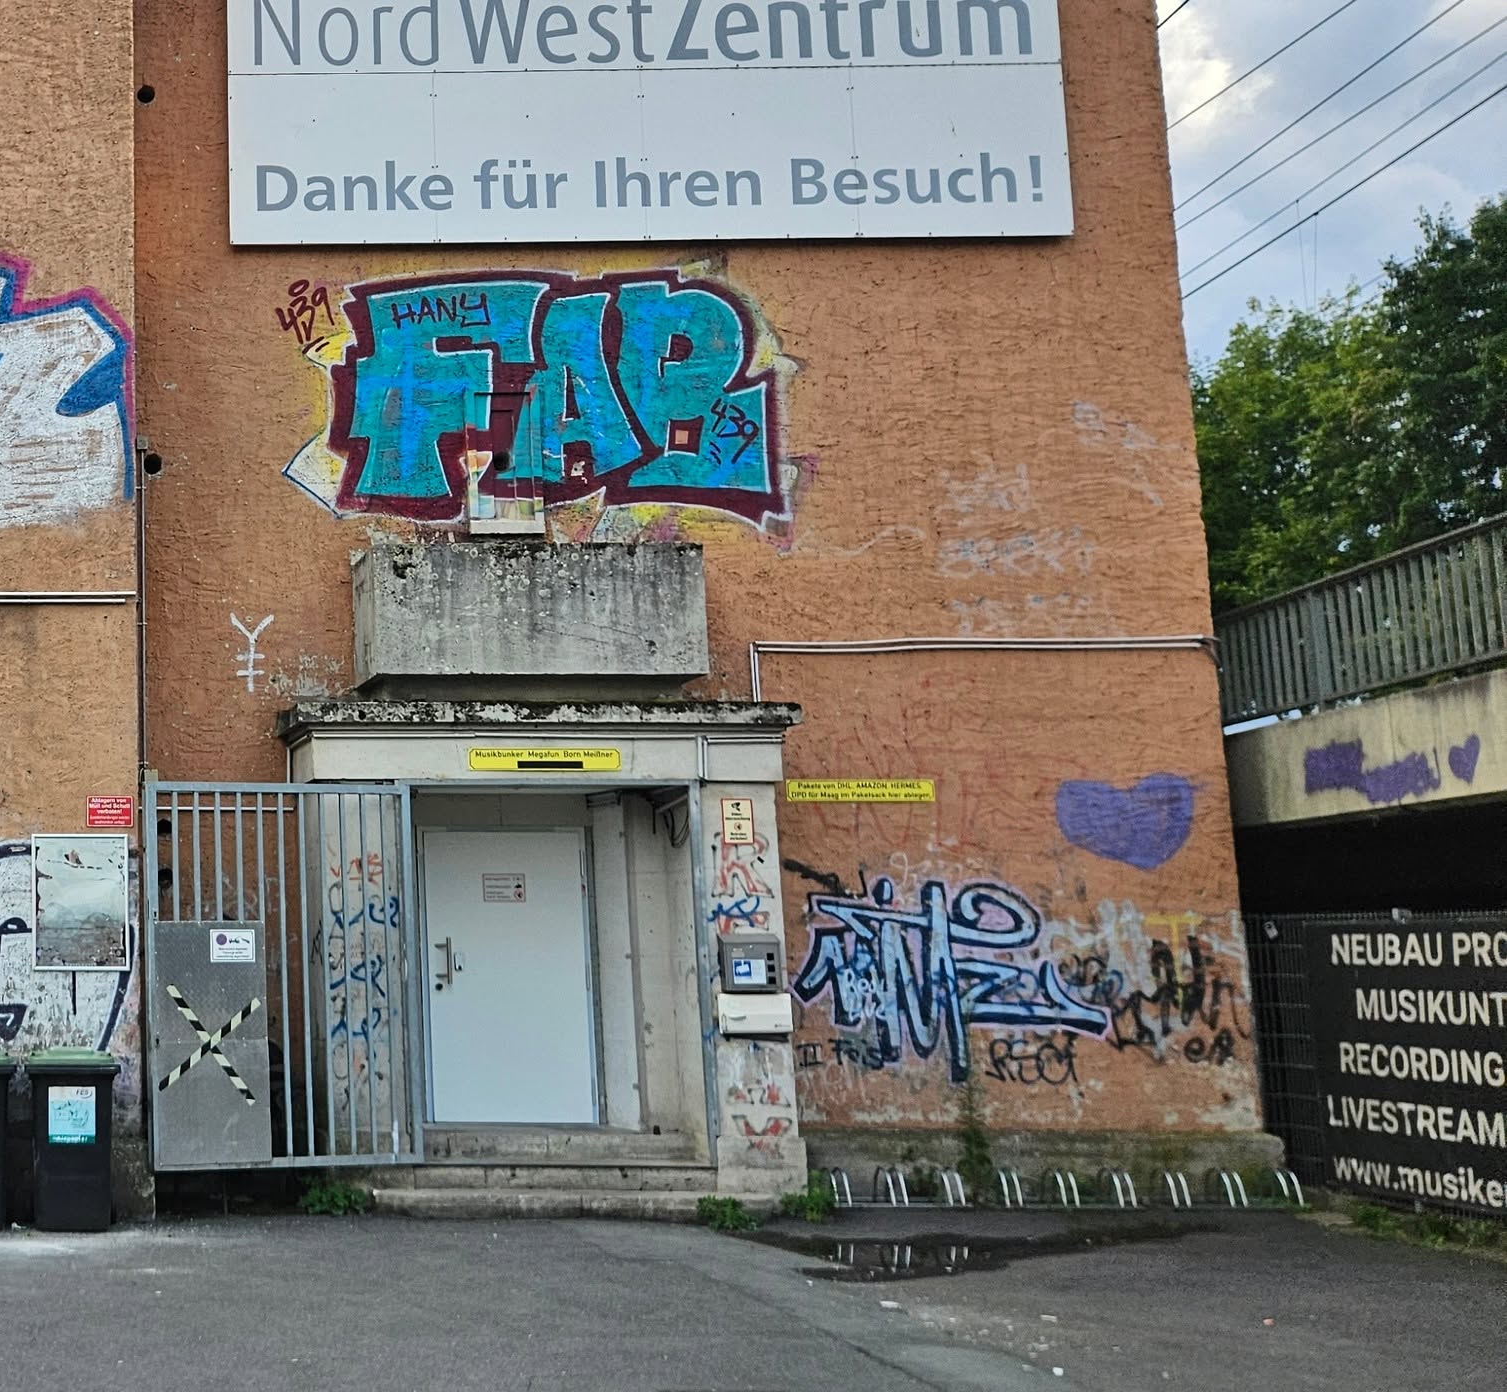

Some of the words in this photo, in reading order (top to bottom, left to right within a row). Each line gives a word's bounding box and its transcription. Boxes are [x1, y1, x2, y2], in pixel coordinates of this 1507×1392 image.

[256, 160, 454, 211] Danke
[473, 159, 568, 209] für
[594, 156, 762, 208] Ihren
[790, 152, 1044, 205] Besuch!
[391, 294, 491, 327] HANY
[528, 751, 560, 759] Megafun
[1331, 932, 1443, 967] NEUBAU
[1355, 987, 1507, 1028] MUSIKUNT
[1339, 1041, 1506, 1087] RECORDING
[1327, 1094, 1507, 1149] LIVESTREAM
[1334, 1155, 1507, 1210] www.musike
